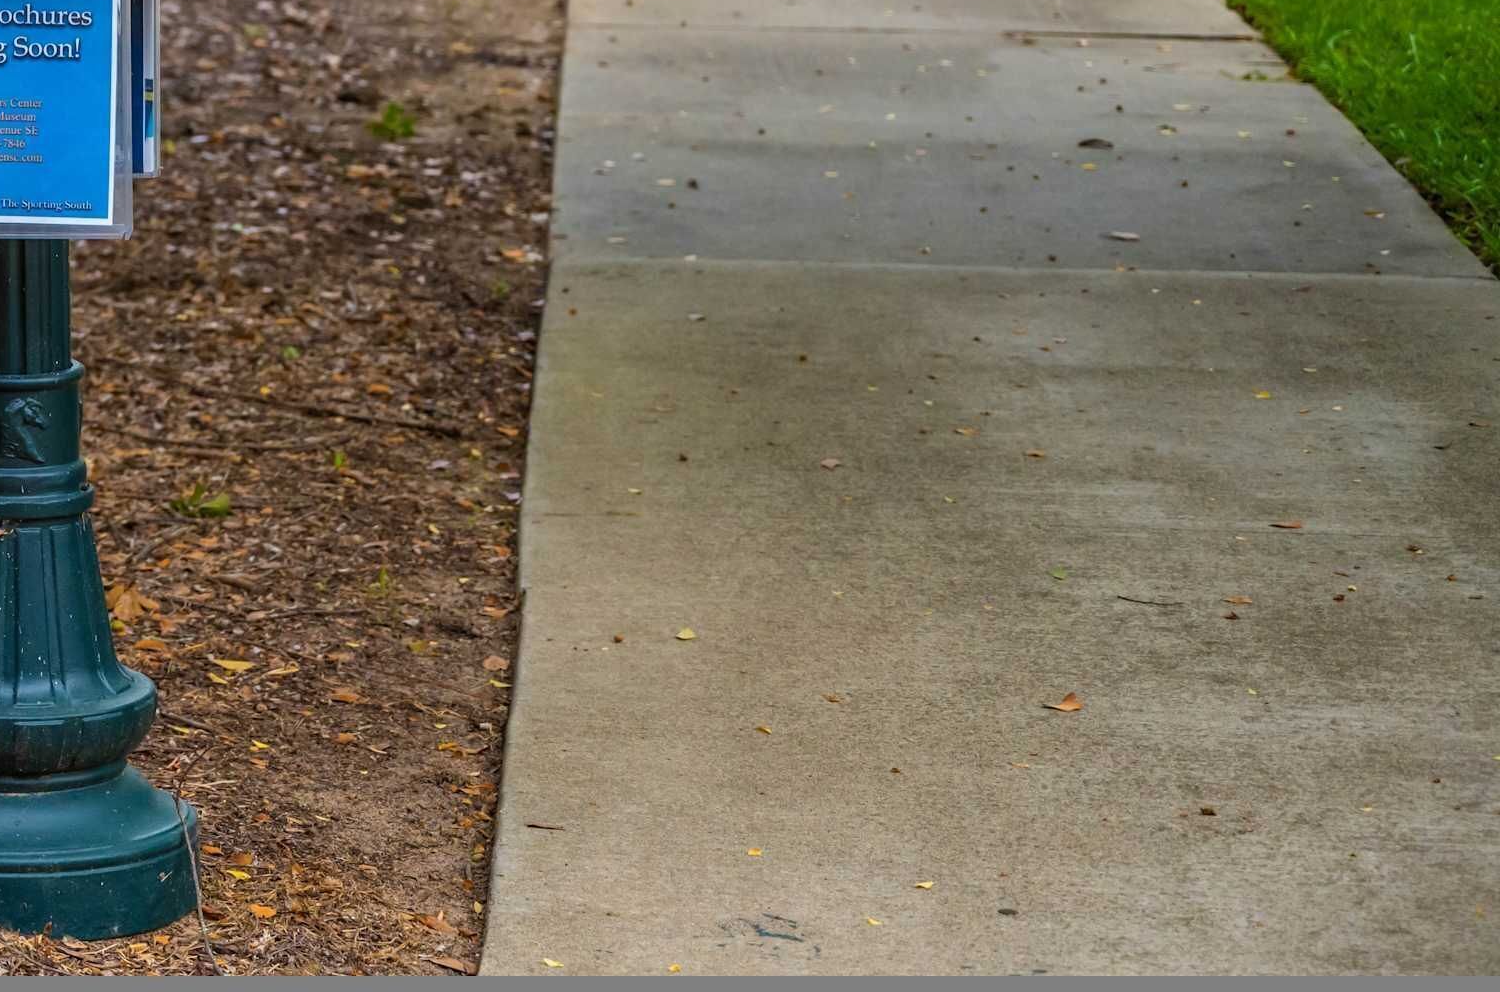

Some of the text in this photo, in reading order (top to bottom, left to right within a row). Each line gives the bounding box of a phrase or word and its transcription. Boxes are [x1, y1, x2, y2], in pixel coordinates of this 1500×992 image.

[13, 35, 81, 58] Soon!
[10, 97, 42, 108] Center
[1, 198, 18, 208] The
[21, 199, 62, 212] Sporting
[64, 199, 93, 210] South
